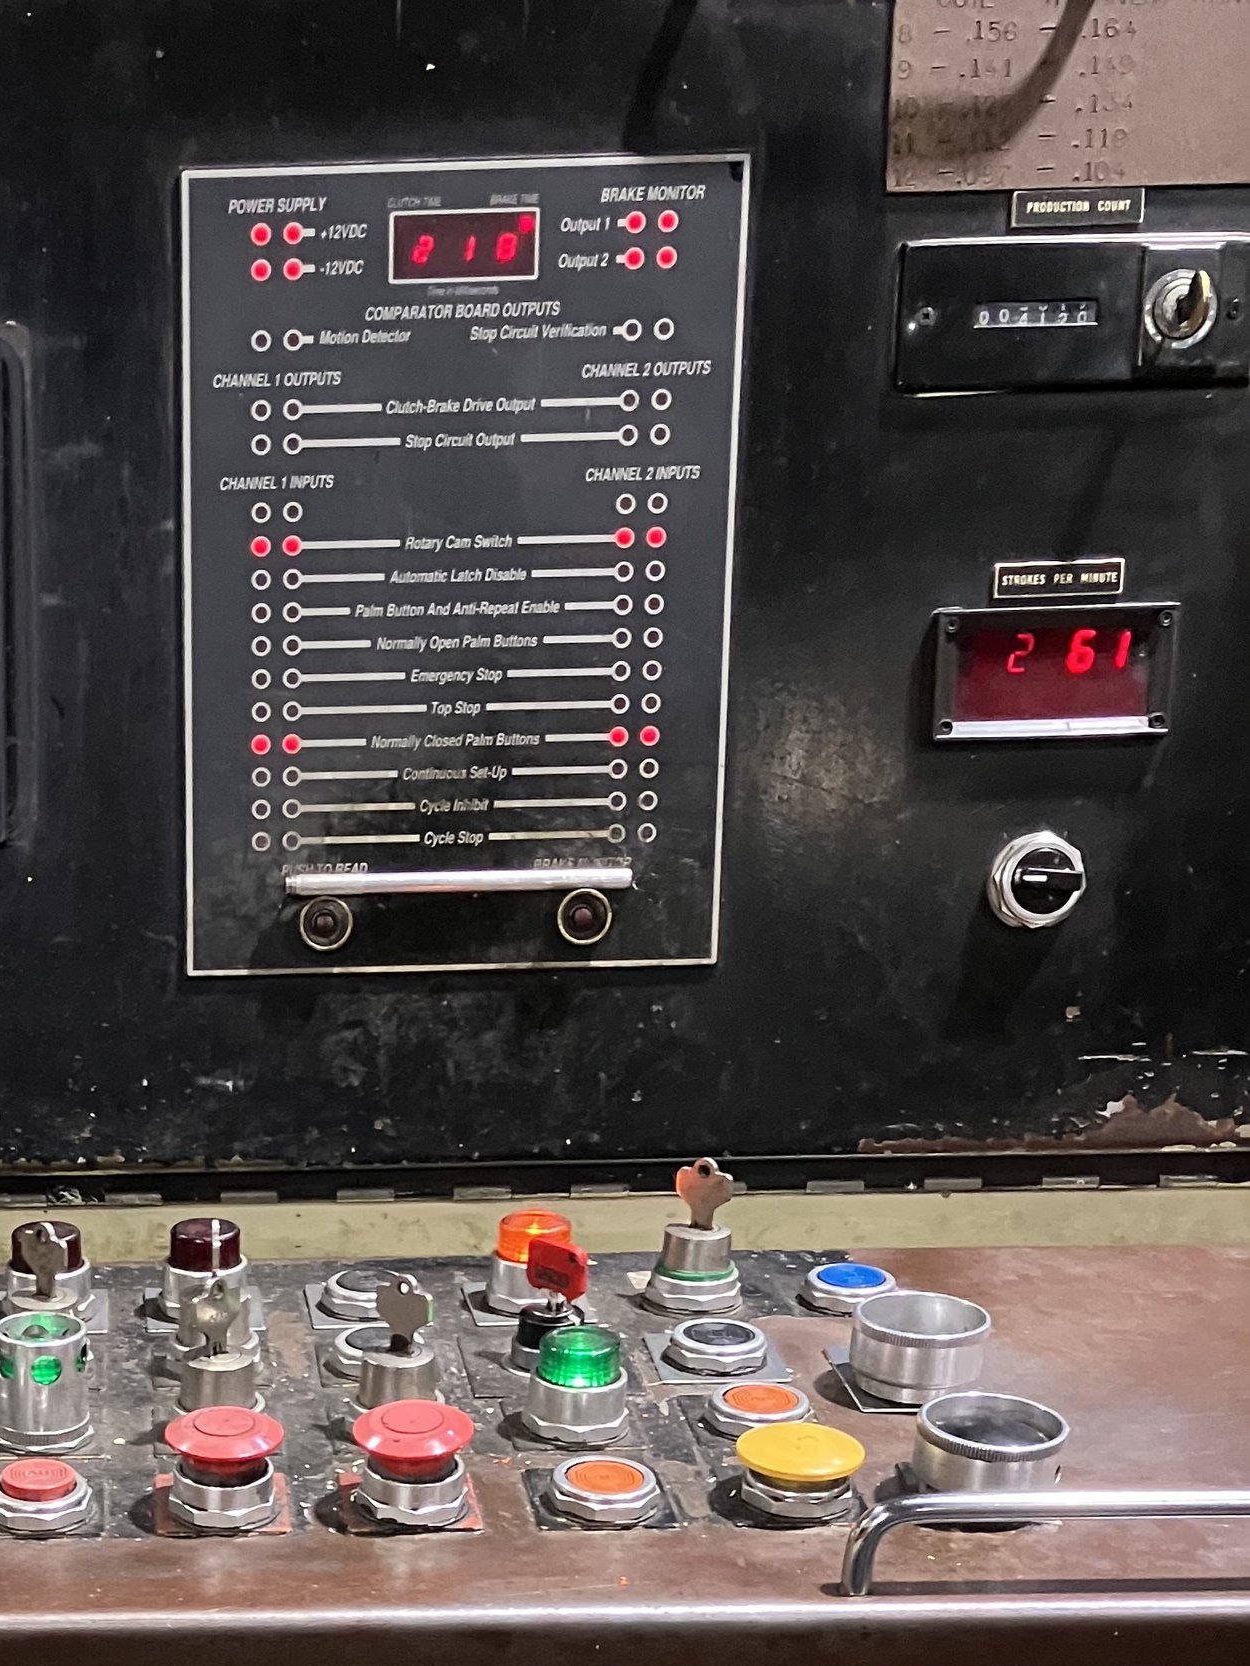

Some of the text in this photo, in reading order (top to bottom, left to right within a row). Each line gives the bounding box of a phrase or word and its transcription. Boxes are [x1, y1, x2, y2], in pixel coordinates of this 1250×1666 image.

[601, 185, 705, 202] BRAKE MONITOR
[228, 197, 326, 214] POWER SUPPLY
[1027, 200, 1131, 213] PRODUCTION COUNT
[321, 224, 367, 239] +12VDC
[561, 218, 601, 235] Output
[320, 260, 364, 275] -12VDC
[559, 254, 598, 271] Output
[365, 301, 560, 321] COMPARATOR BOARD OUTPUTS
[320, 329, 411, 344] Motion Detector
[470, 323, 606, 343] Stop Circuit Verification
[582, 363, 639, 378] CHANNEL
[654, 360, 711, 376] OUTPUTS
[213, 373, 270, 388] CHANNEL
[284, 371, 341, 386] OUTPUTS
[386, 398, 536, 414] Clutch-Brake Drive Output
[406, 433, 515, 451] Stop Circuit Output
[586, 467, 642, 481] CHANNEL
[656, 465, 700, 480] INPUTS
[220, 476, 276, 490] CHANNEL
[290, 475, 334, 488] INPUTS
[406, 535, 512, 552] Rotary Cam Switch
[390, 568, 526, 583] Automatic Latch Disable
[1002, 572, 1117, 585] STROKES PER MINUTE
[355, 601, 560, 617] Palm Button And Anti-Repeat Enable
[377, 635, 537, 652] Normally Open Palm Buttons
[411, 668, 502, 684] Emergency Stop
[432, 701, 480, 716] Top Stop
[371, 733, 539, 751] Normally Closed Palm Buttons
[403, 766, 507, 781] Continuous Set-Up
[420, 799, 489, 815] Cycle Inhibit
[424, 831, 483, 847] Cycle Stop
